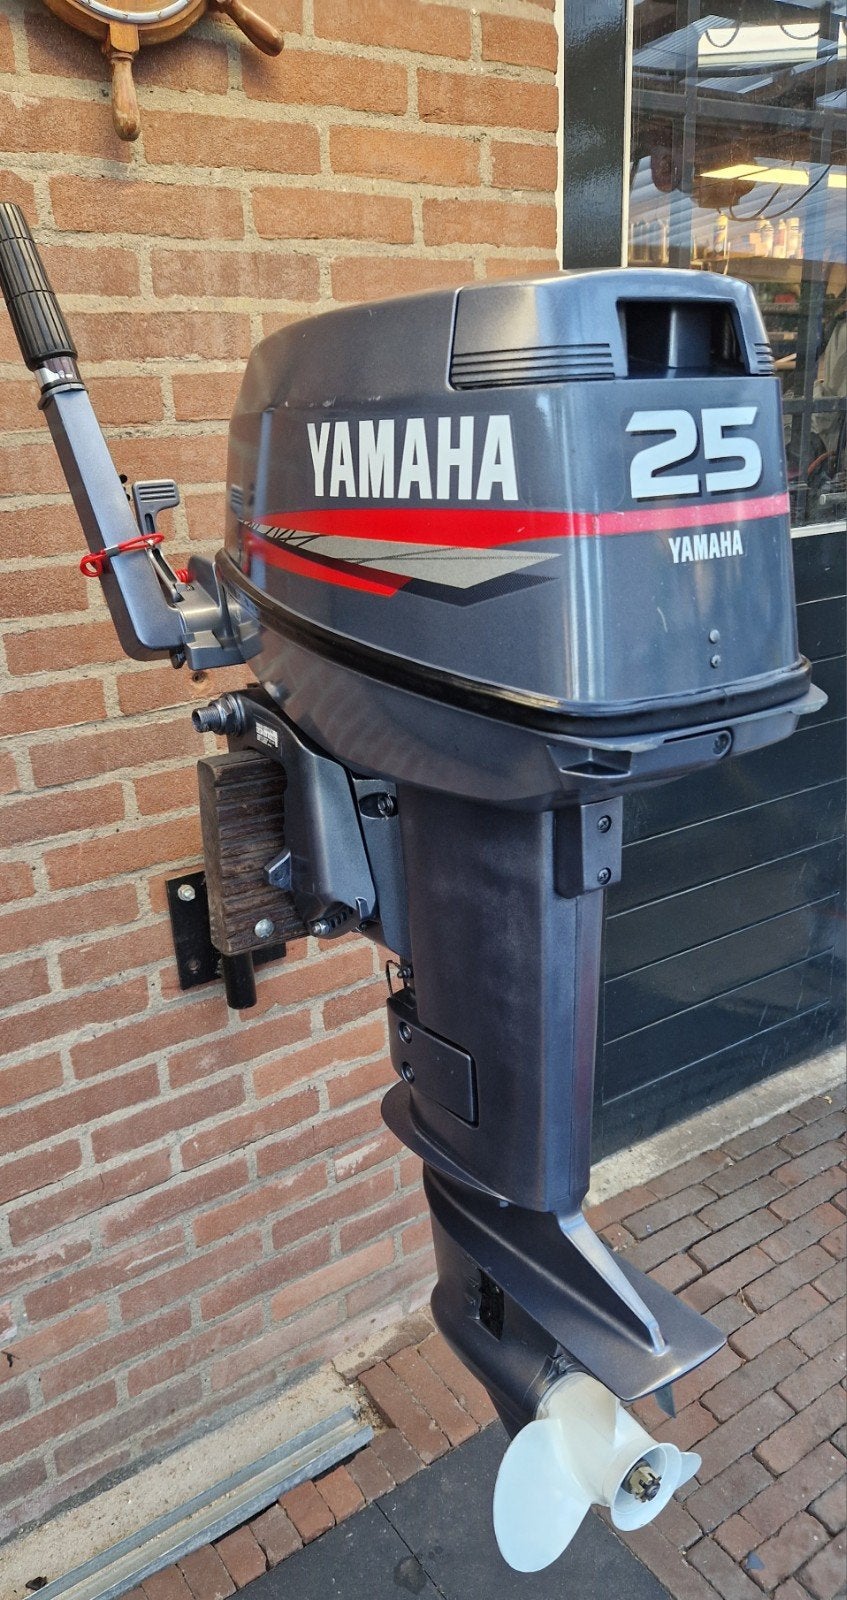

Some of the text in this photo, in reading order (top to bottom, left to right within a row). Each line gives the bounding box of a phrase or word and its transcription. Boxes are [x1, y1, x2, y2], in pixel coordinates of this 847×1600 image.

[306, 414, 519, 501] YAMAHA
[625, 406, 762, 499] 25
[668, 529, 744, 564] YAMAHA
